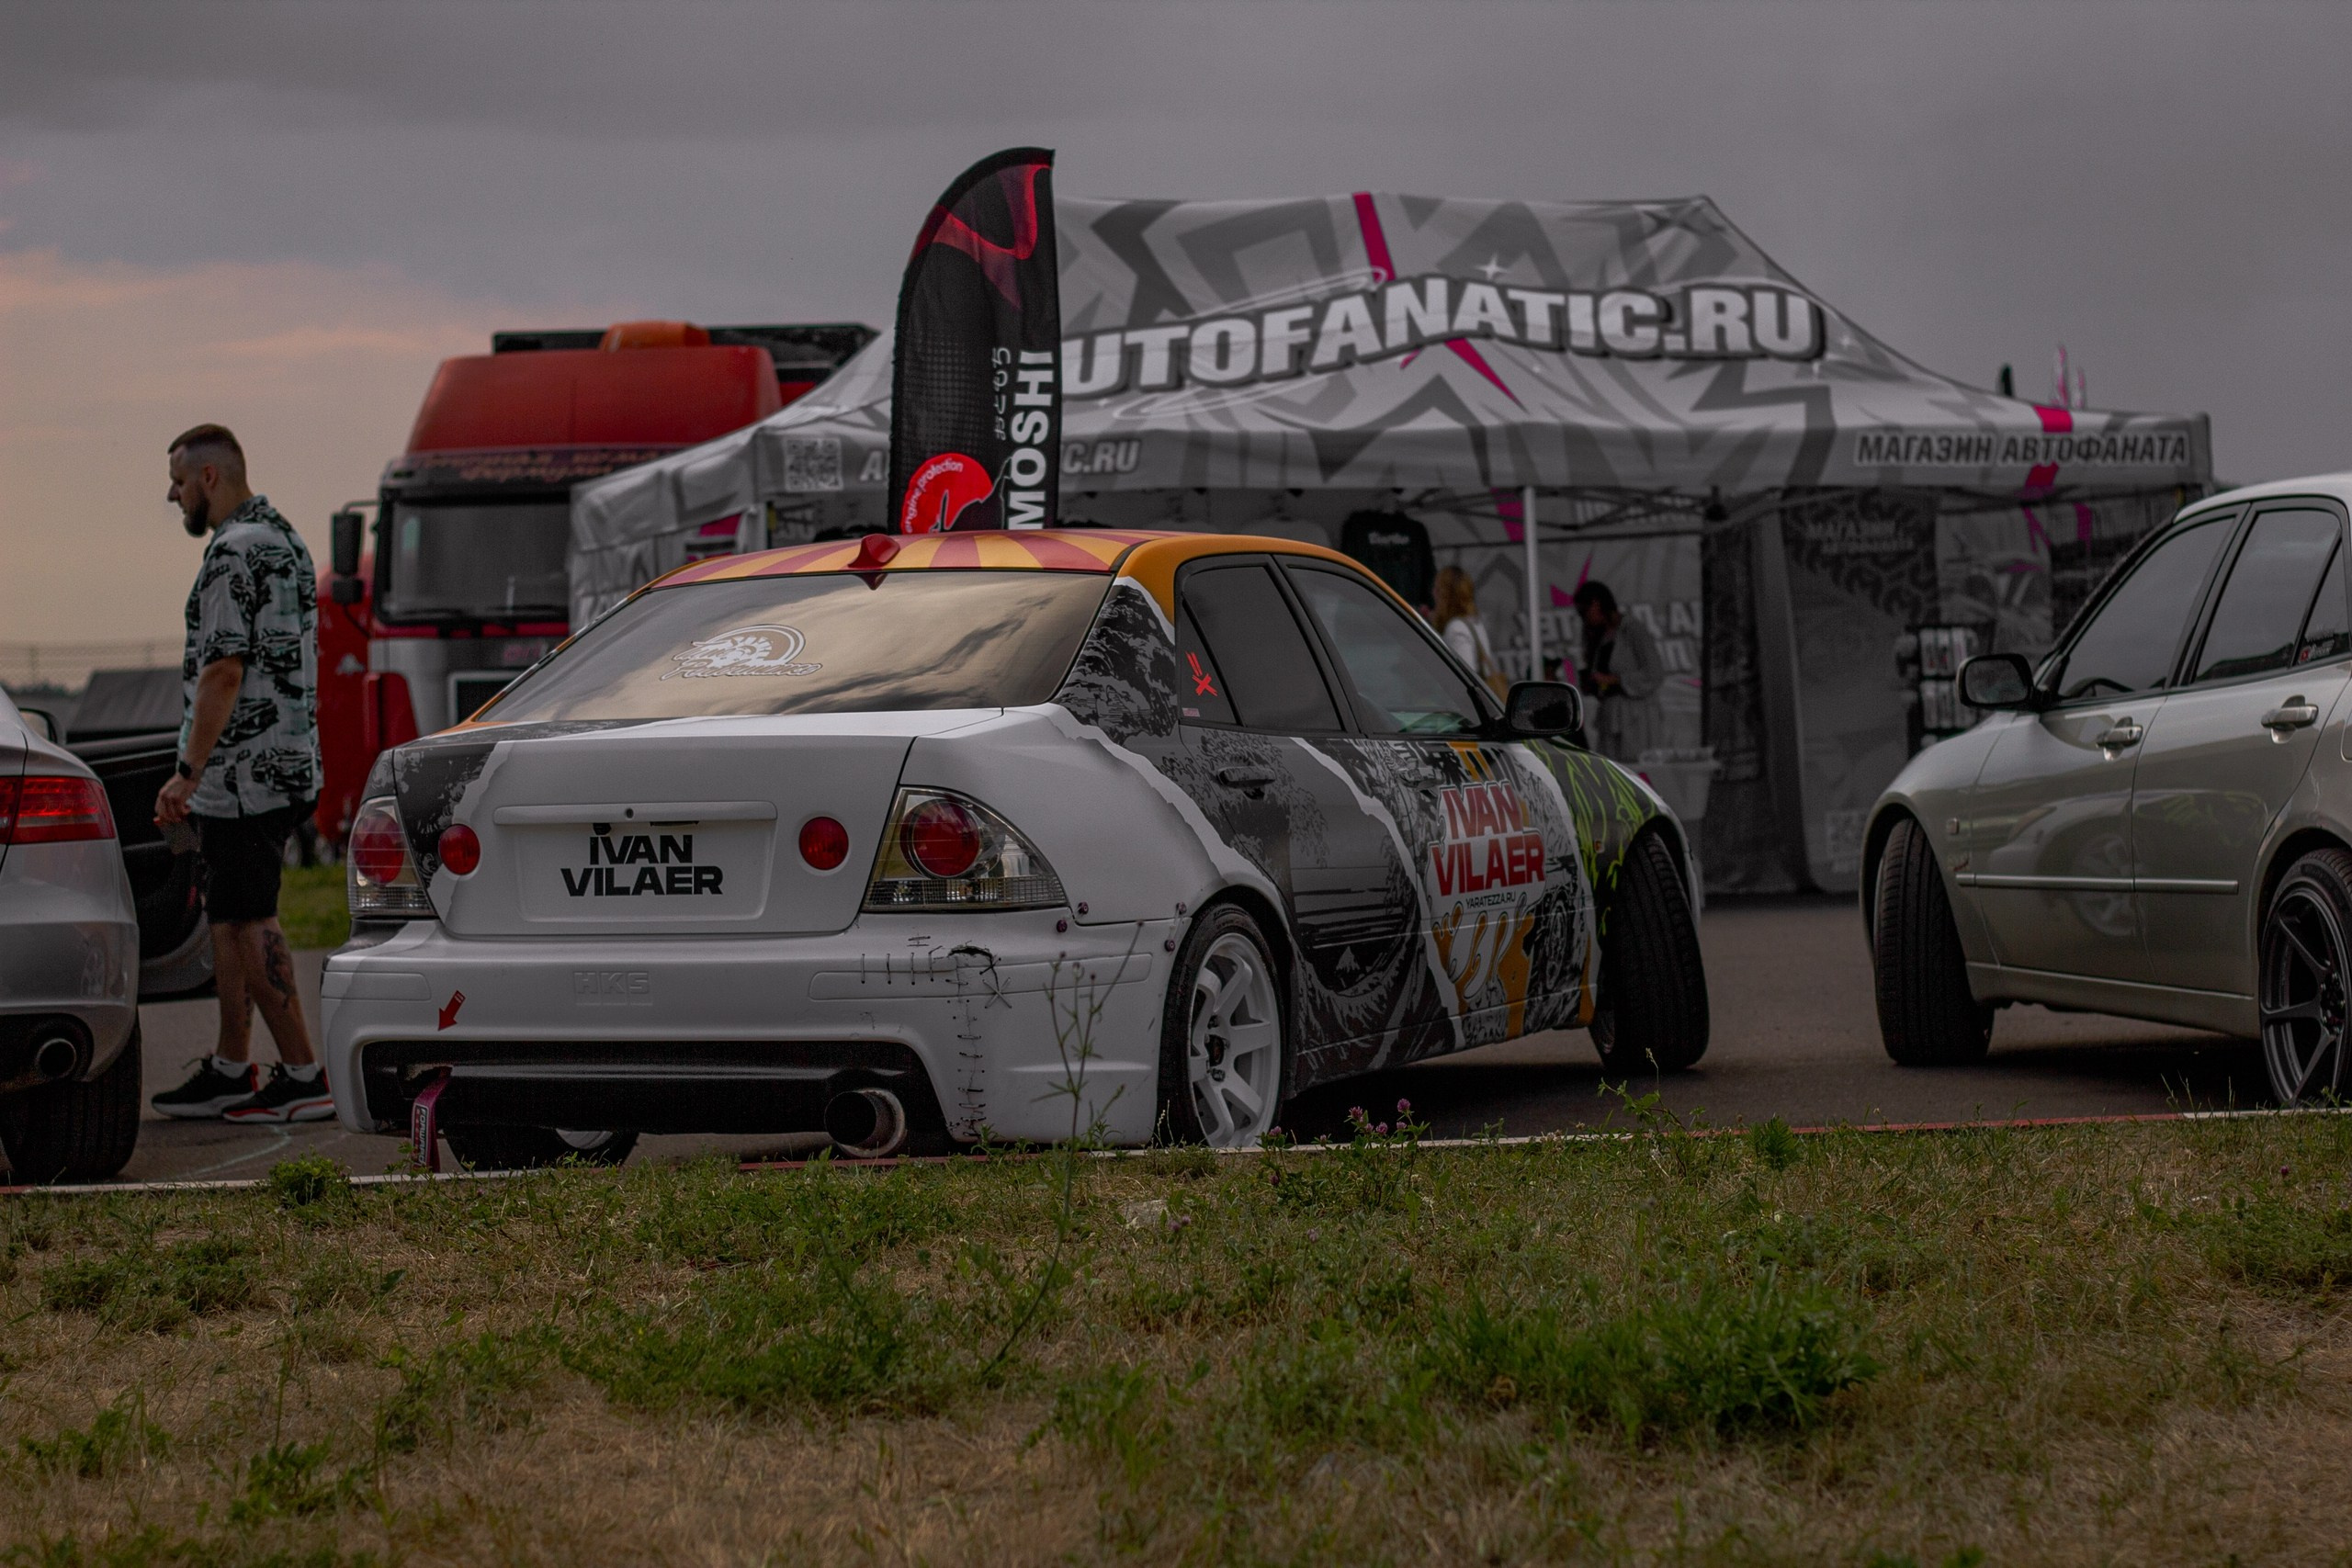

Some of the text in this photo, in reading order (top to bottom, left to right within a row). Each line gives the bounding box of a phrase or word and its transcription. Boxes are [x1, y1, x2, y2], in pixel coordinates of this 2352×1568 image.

[1060, 276, 1816, 398] UTOFANATIC.RU
[1857, 434, 2187, 462] МАГАЗИН АВТОФАНАТА
[904, 457, 965, 534] engine protection
[1442, 784, 1523, 840] IVAN
[590, 834, 693, 864] IVAN
[1430, 833, 1546, 897] VILAER
[560, 865, 724, 897] VILAER
[1465, 892, 1516, 908] YARATEZZA.RU
[573, 970, 650, 995] HKS
[419, 1108, 427, 1164] FORWARD
